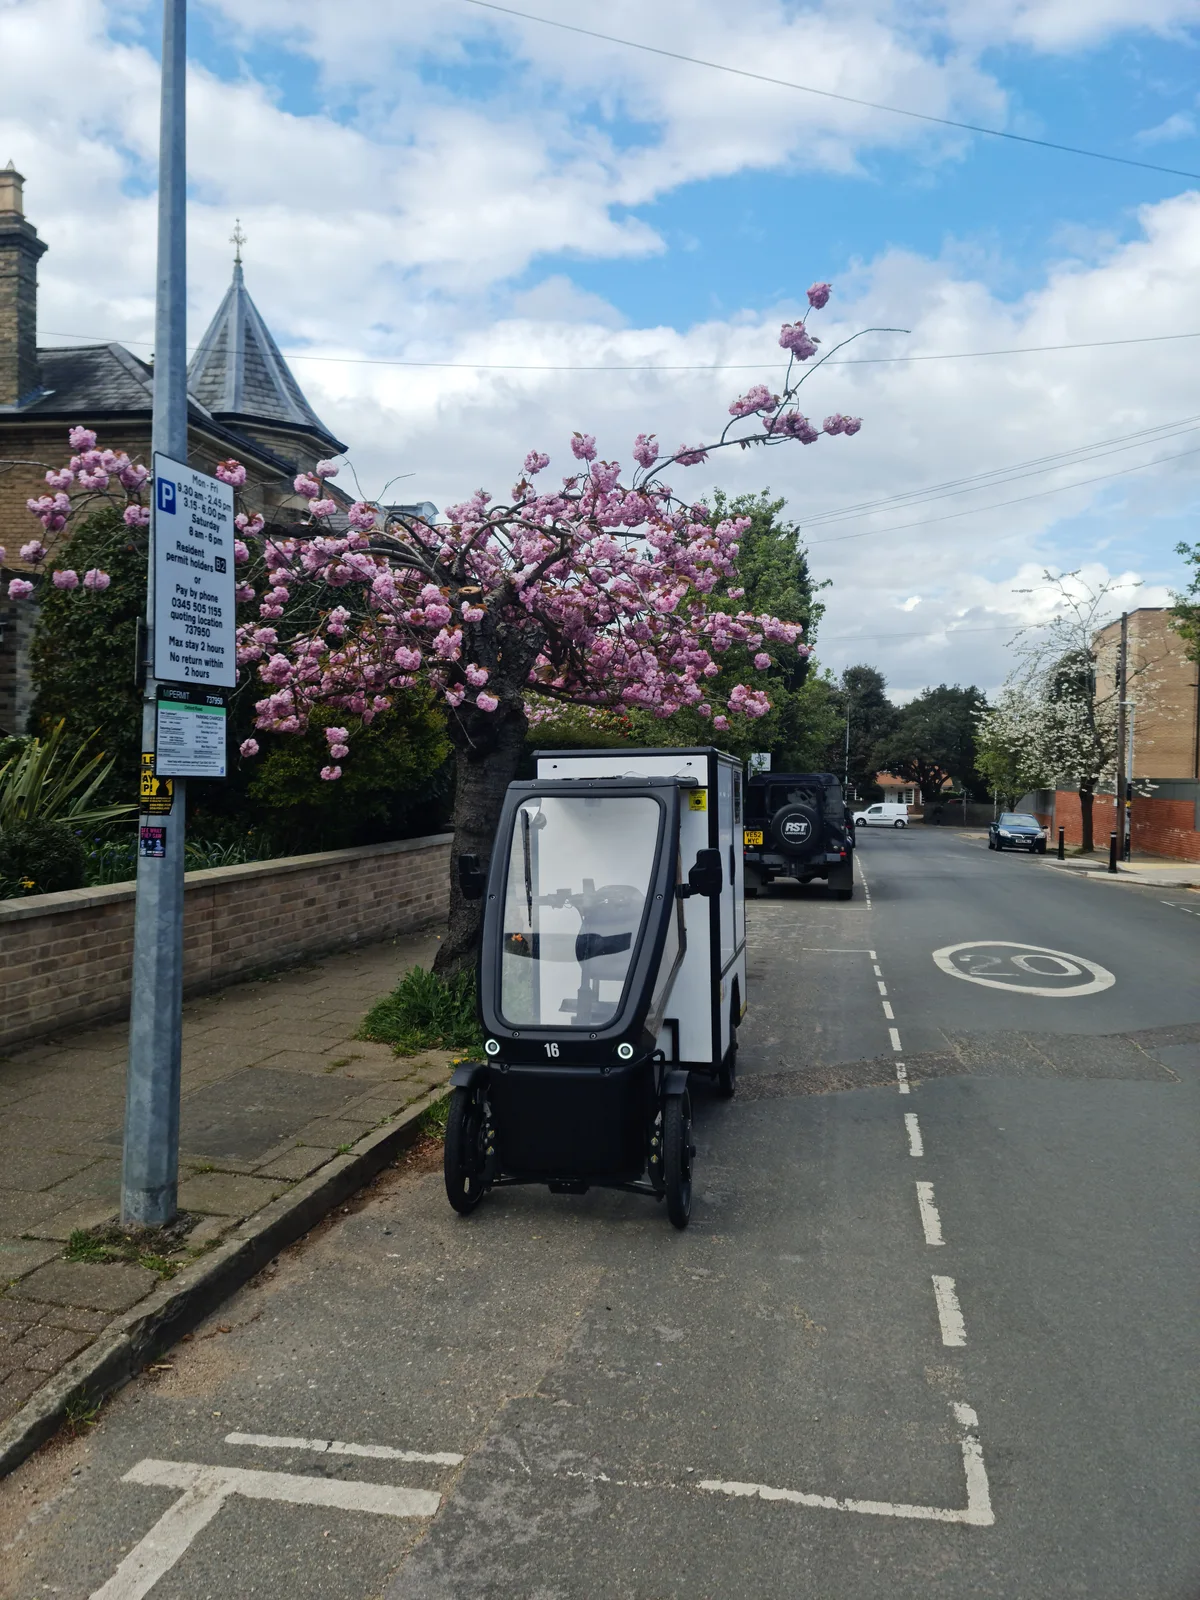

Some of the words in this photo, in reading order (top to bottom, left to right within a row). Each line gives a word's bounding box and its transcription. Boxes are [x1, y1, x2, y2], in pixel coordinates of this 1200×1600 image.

[192, 475, 205, 487] Mon
[210, 482, 218, 493] Fri
[162, 482, 174, 508] P
[178, 482, 193, 496] 9.30
[194, 491, 204, 501] am
[208, 495, 222, 508] 2.45
[222, 502, 231, 512] pm
[184, 497, 197, 510] 3.15
[202, 505, 217, 518] 6.00
[218, 513, 226, 521] pm
[192, 514, 220, 533] Saturday
[189, 526, 193, 536] 8
[195, 530, 204, 539] am
[208, 533, 213, 542] 6
[214, 537, 223, 546] pm
[176, 541, 204, 558] Resident
[166, 552, 188, 566] permit
[190, 557, 213, 572] holders
[176, 584, 188, 597] Pay
[190, 588, 197, 600] by
[199, 591, 218, 603] phone
[172, 597, 191, 610] 0345
[193, 602, 206, 614] 505
[208, 606, 222, 617] 1155
[171, 611, 196, 625] quoting
[198, 615, 222, 628] location
[185, 624, 210, 638] 737950
[169, 636, 183, 647] Max
[185, 641, 199, 652] stay
[201, 642, 205, 651] 2
[207, 644, 224, 654] hours
[170, 652, 180, 662] No
[182, 656, 202, 665] return
[204, 658, 223, 668] within
[185, 666, 189, 676] 2
[191, 669, 209, 678] hours
[785, 822, 808, 832] RST
[960, 954, 1082, 976] 20
[544, 1042, 560, 1057] 16
